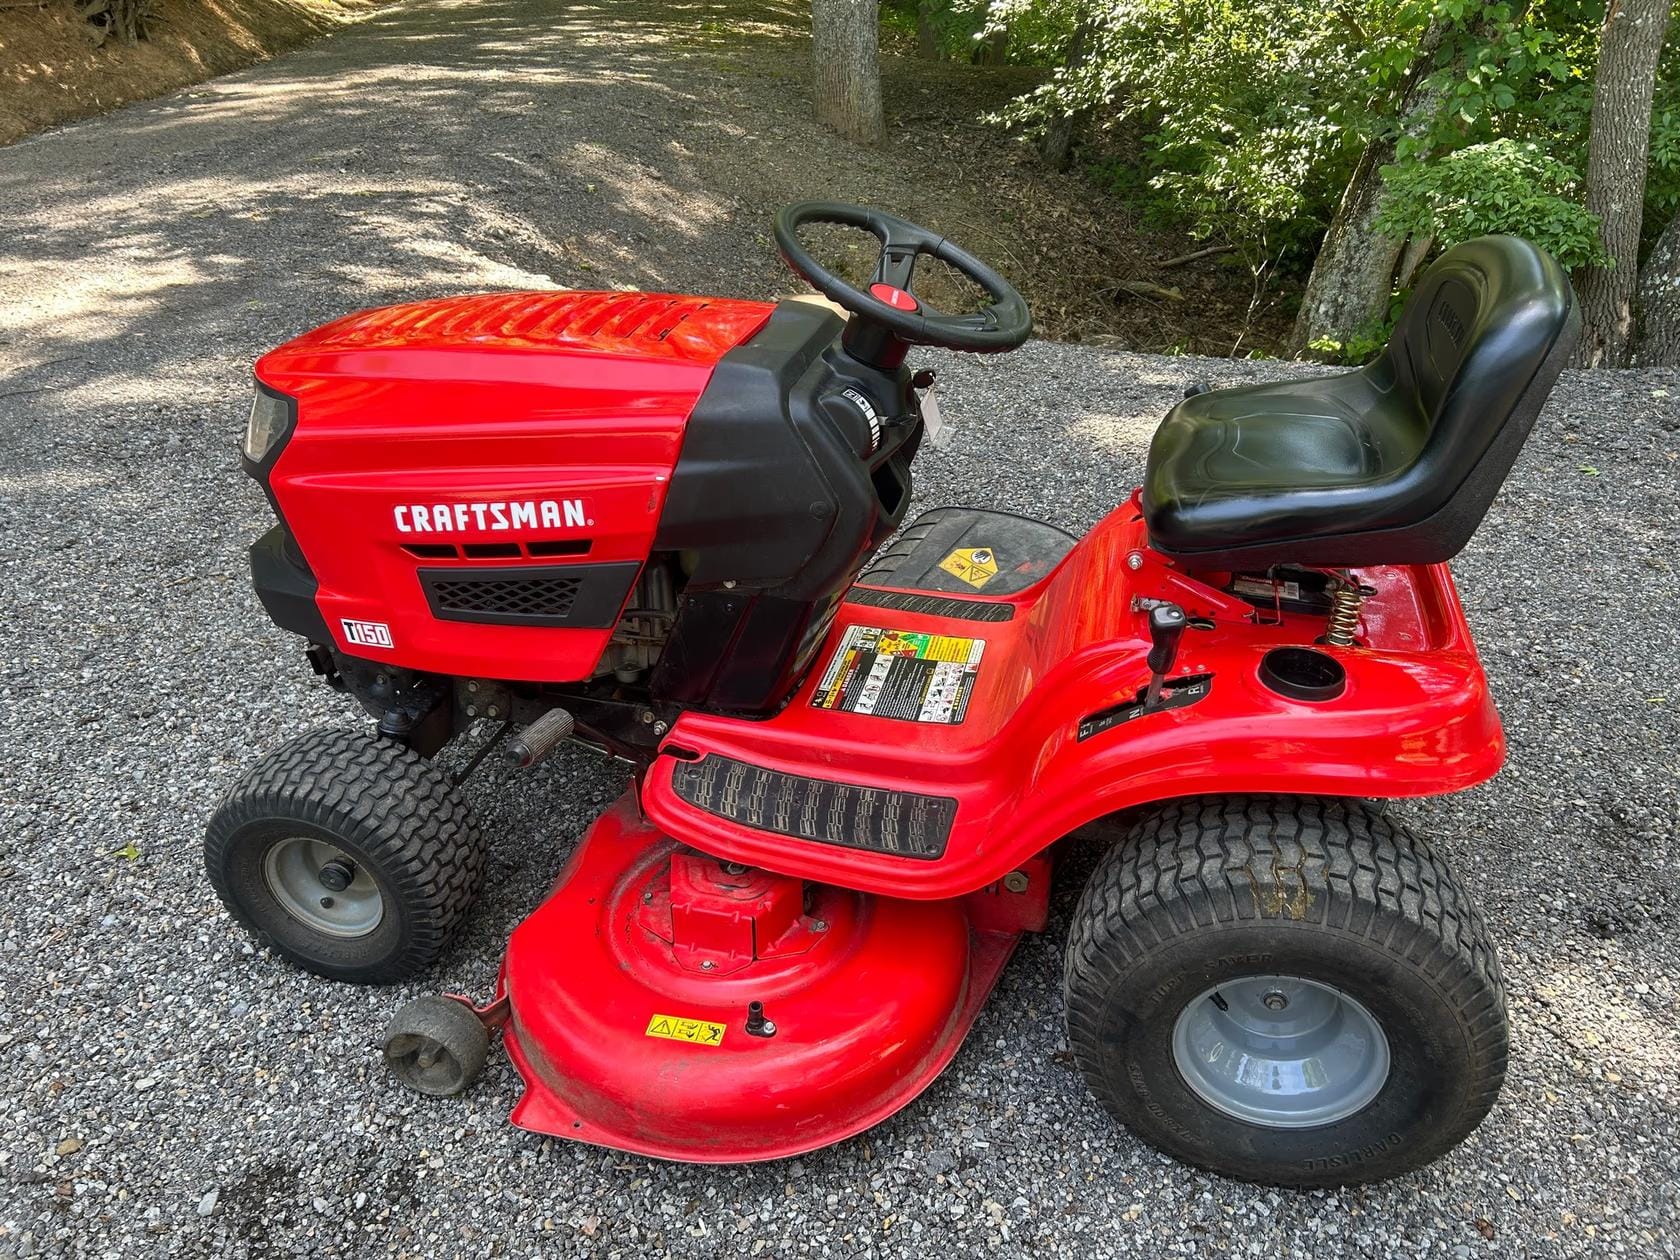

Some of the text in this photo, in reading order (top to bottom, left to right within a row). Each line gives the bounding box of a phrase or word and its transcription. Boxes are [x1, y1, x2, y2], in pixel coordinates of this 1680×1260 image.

[342, 620, 392, 646] T150
[1188, 686, 1200, 695] R
[1129, 708, 1140, 719] N
[1302, 1131, 1403, 1170] CARLISLE
